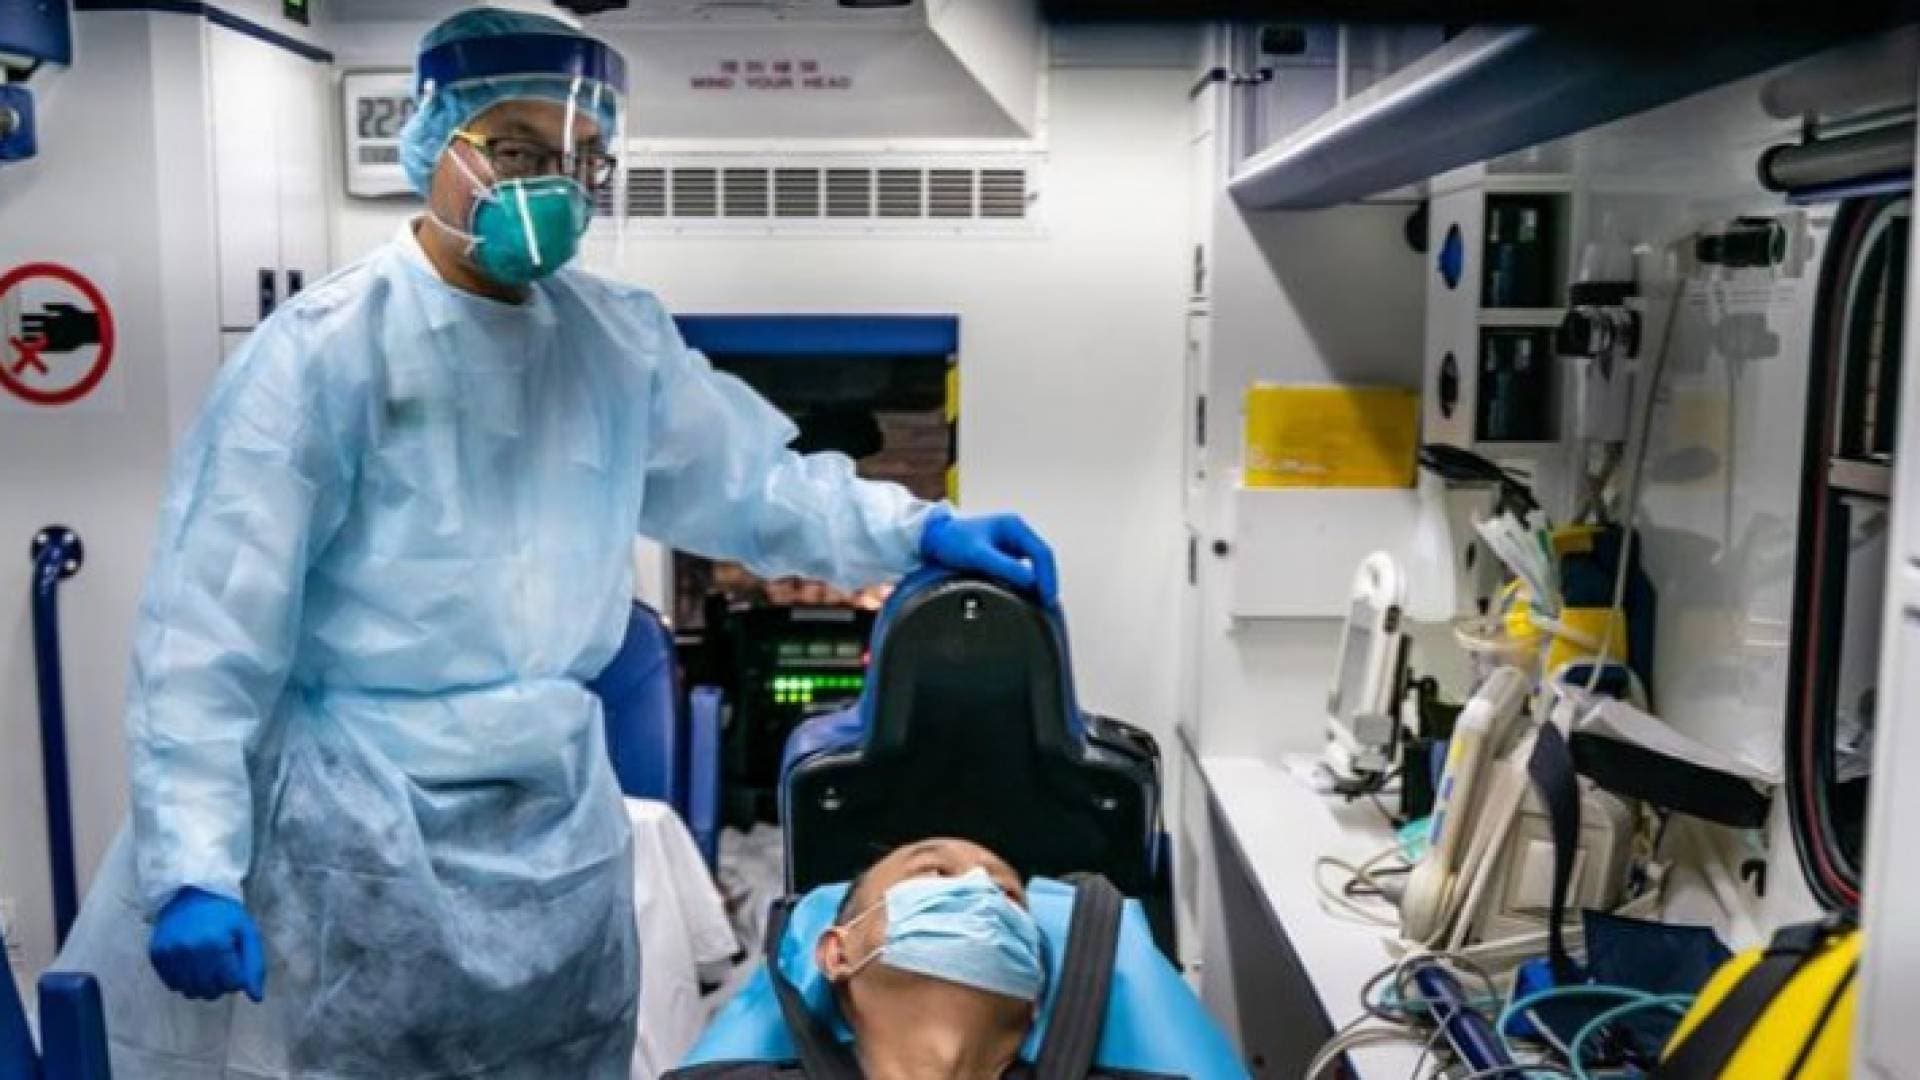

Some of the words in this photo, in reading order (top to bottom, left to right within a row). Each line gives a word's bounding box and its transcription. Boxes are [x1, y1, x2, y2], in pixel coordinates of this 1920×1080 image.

[691, 77, 735, 89] MIND
[746, 77, 794, 89] YOUR
[802, 77, 852, 89] HEAD
